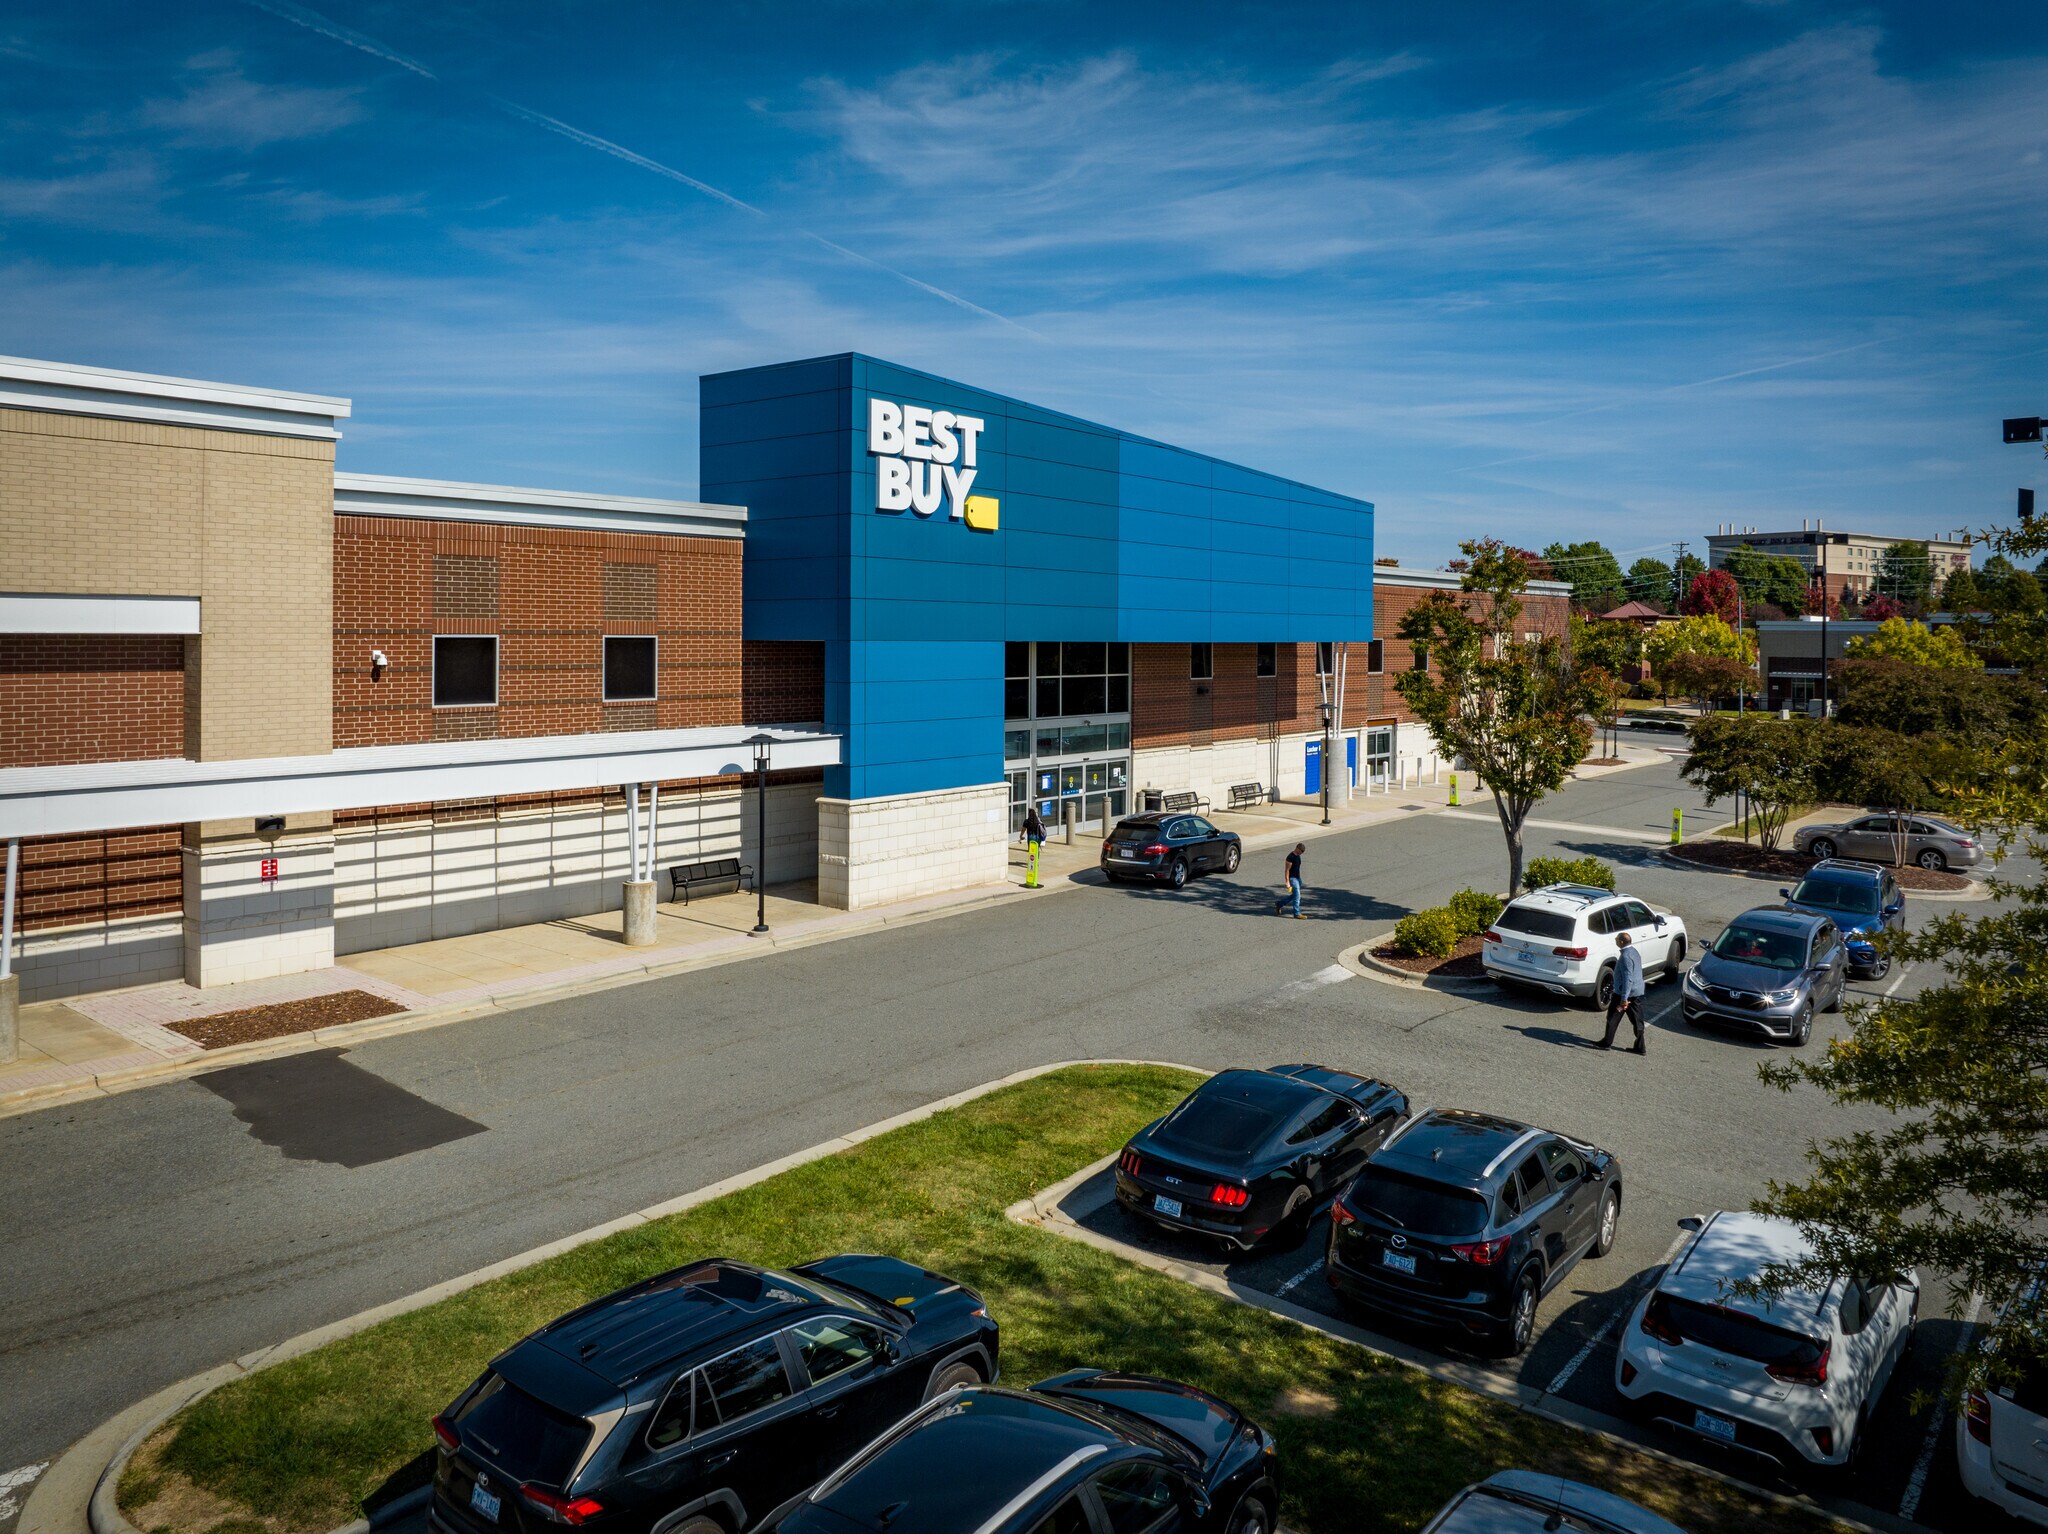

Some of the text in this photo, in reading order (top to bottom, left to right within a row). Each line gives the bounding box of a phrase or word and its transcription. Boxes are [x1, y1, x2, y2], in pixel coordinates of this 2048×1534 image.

[869, 398, 984, 466] BEST
[877, 456, 978, 517] BUY
[1165, 1176, 1182, 1185] GT
